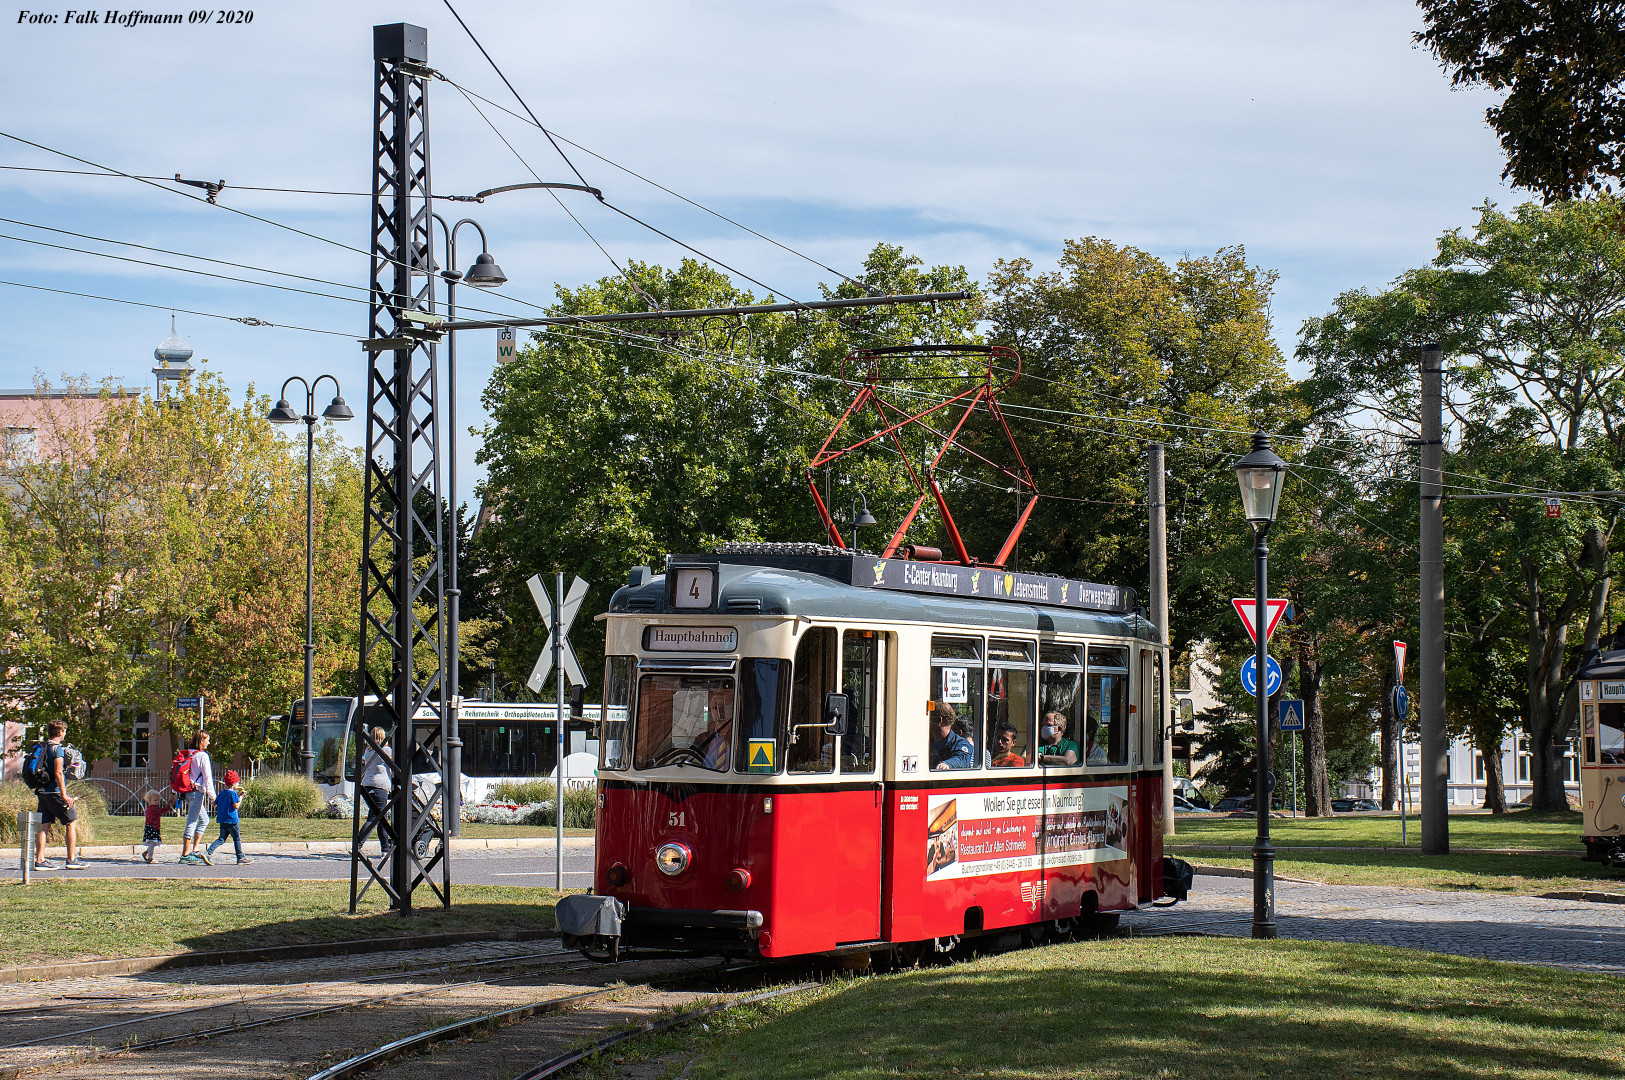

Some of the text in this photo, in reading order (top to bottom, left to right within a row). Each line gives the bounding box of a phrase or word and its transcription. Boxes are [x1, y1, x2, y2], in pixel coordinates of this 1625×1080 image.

[501, 331, 512, 340] 03
[499, 346, 513, 356] W
[904, 564, 958, 592] E-Center Naumburg
[689, 577, 700, 600] 4
[994, 574, 1048, 600] Wir Lebensmittel
[654, 630, 734, 644] Hauptbahnhof
[1586, 684, 1590, 696] 4
[984, 797, 1005, 812] Wollen
[1006, 796, 1015, 810] Sie
[1016, 798, 1026, 814] gut
[1028, 798, 1044, 810] essen
[1053, 793, 1084, 810] Naumburg?
[1588, 800, 1594, 810] 17
[668, 812, 685, 827] 51
[960, 839, 1027, 856] Restaurant Zur Alten Schmiede
